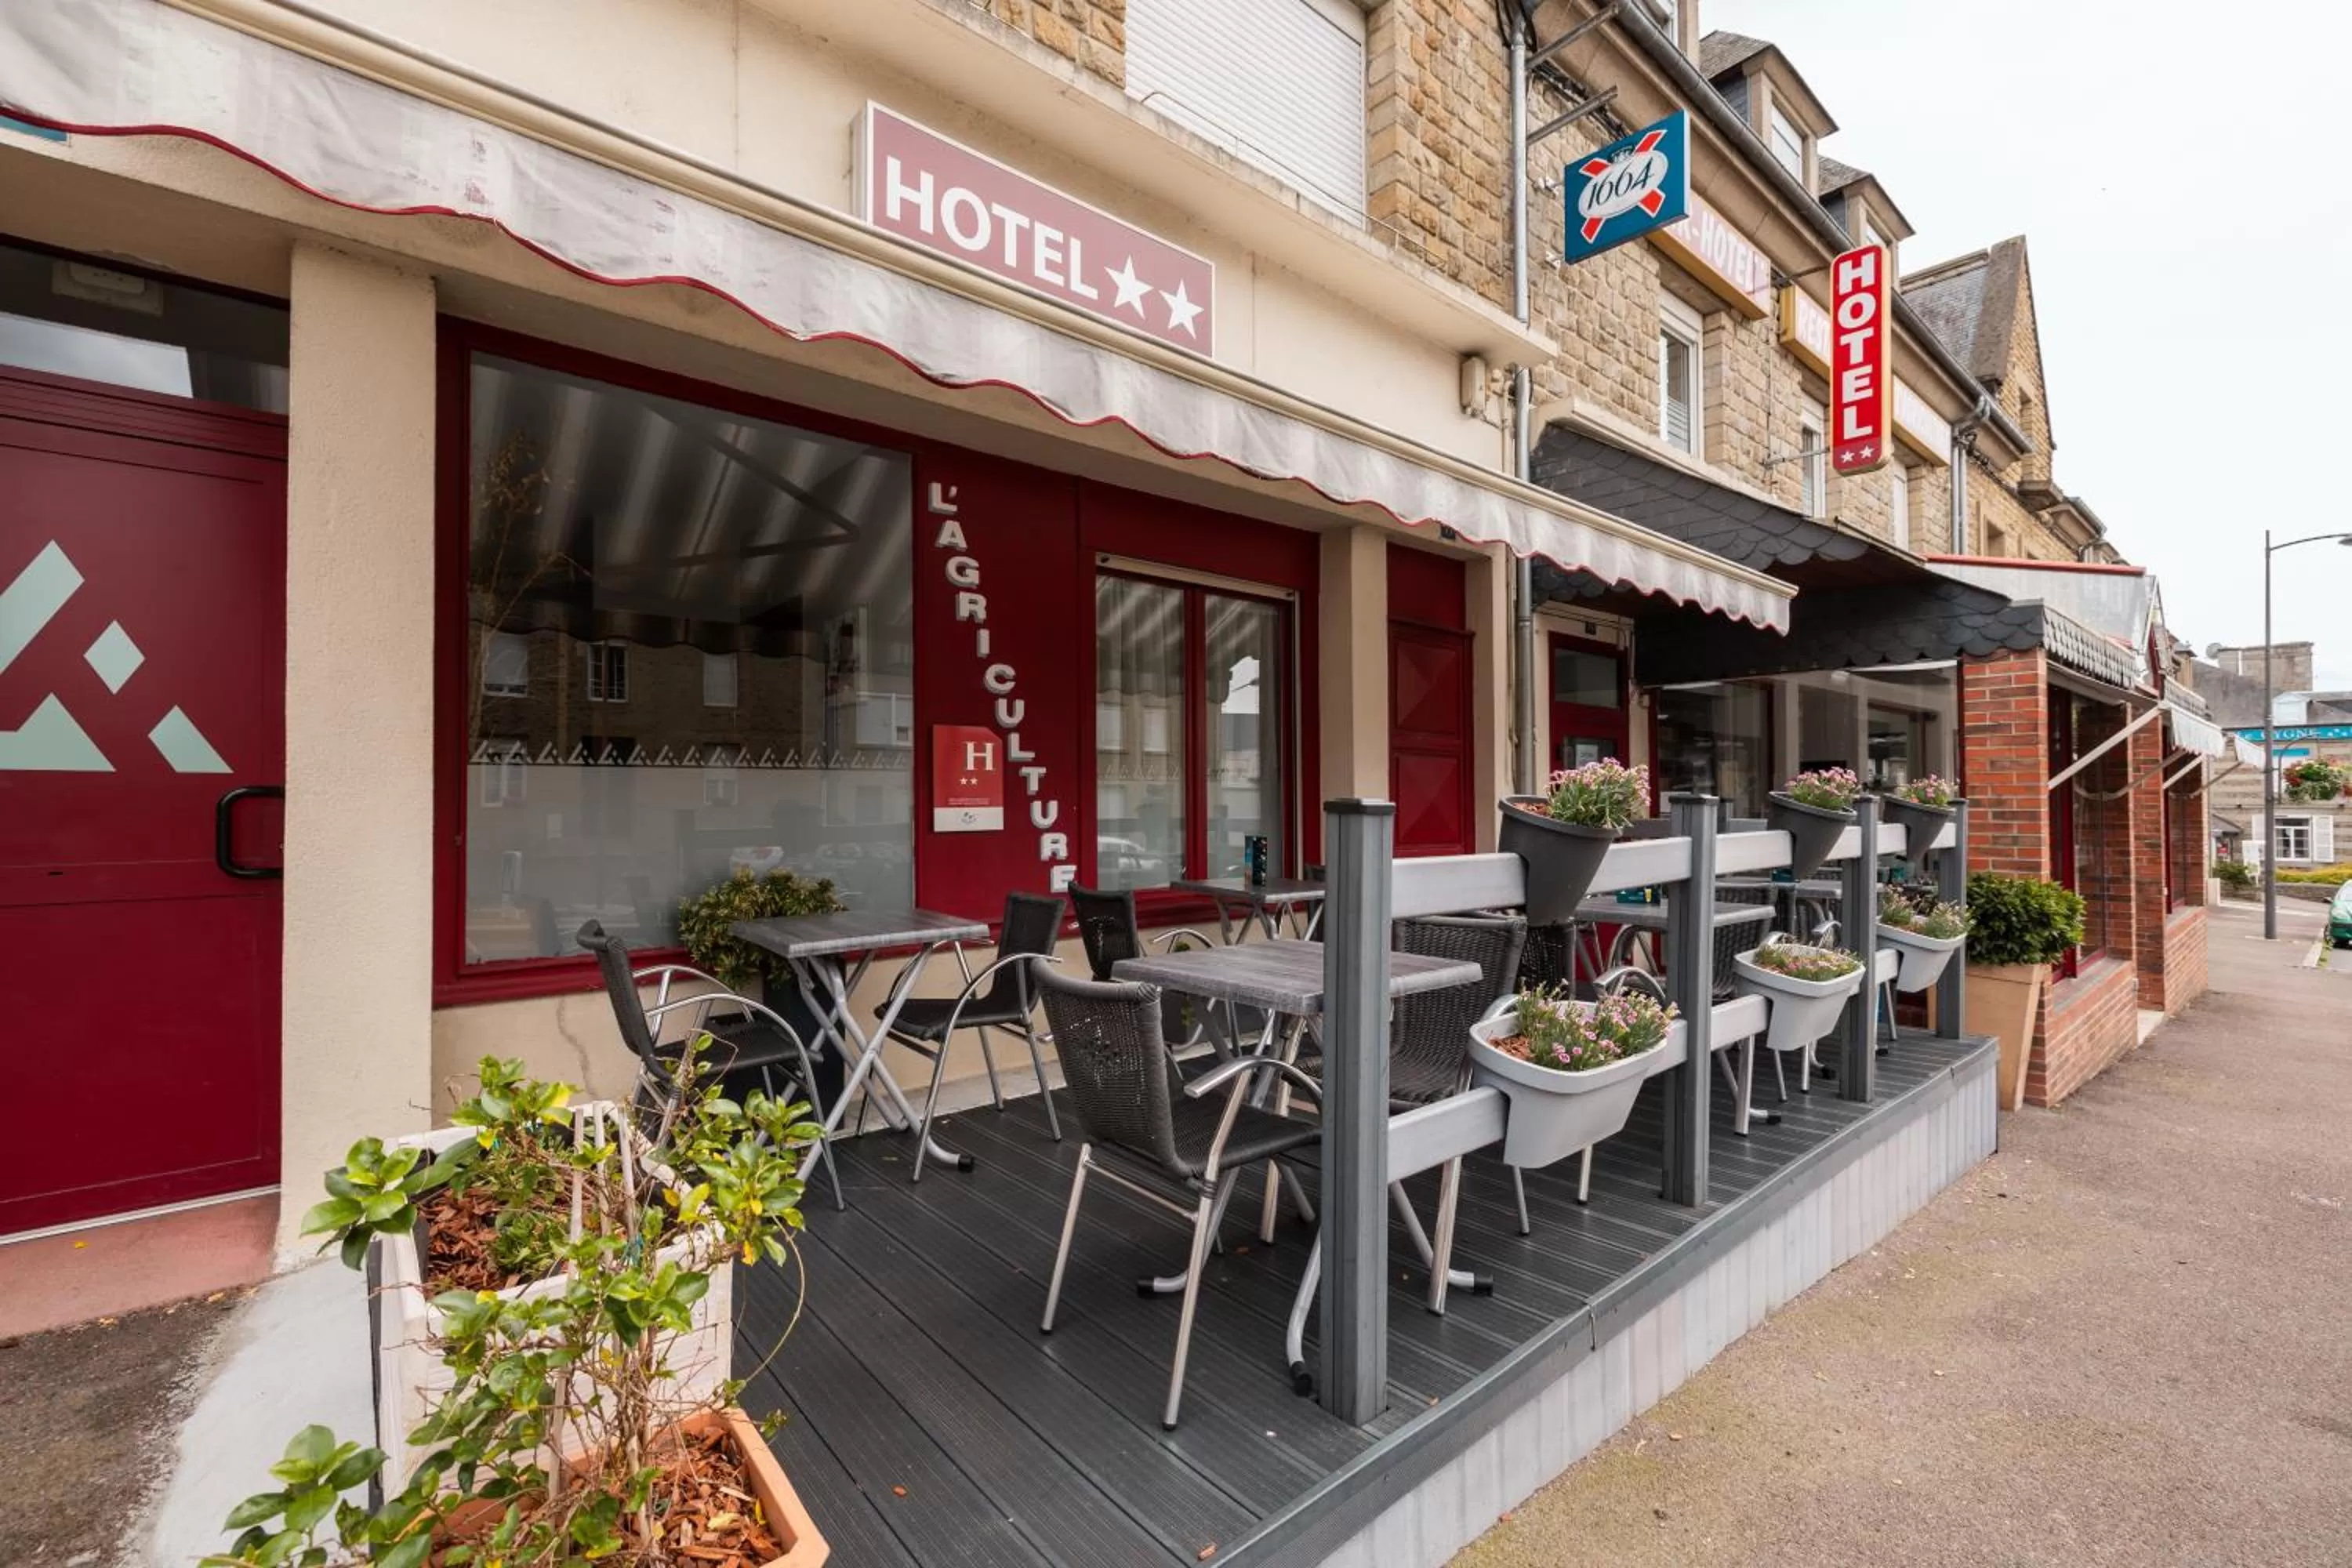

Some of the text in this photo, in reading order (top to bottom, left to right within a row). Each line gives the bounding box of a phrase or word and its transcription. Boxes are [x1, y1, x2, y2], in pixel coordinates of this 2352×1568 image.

[887, 155, 1098, 300] HOTEL
[1587, 158, 1654, 210] 1664
[1838, 252, 1876, 440] HOTEL
[928, 481, 1077, 893] L'AGRICULTURE
[963, 741, 996, 771] H
